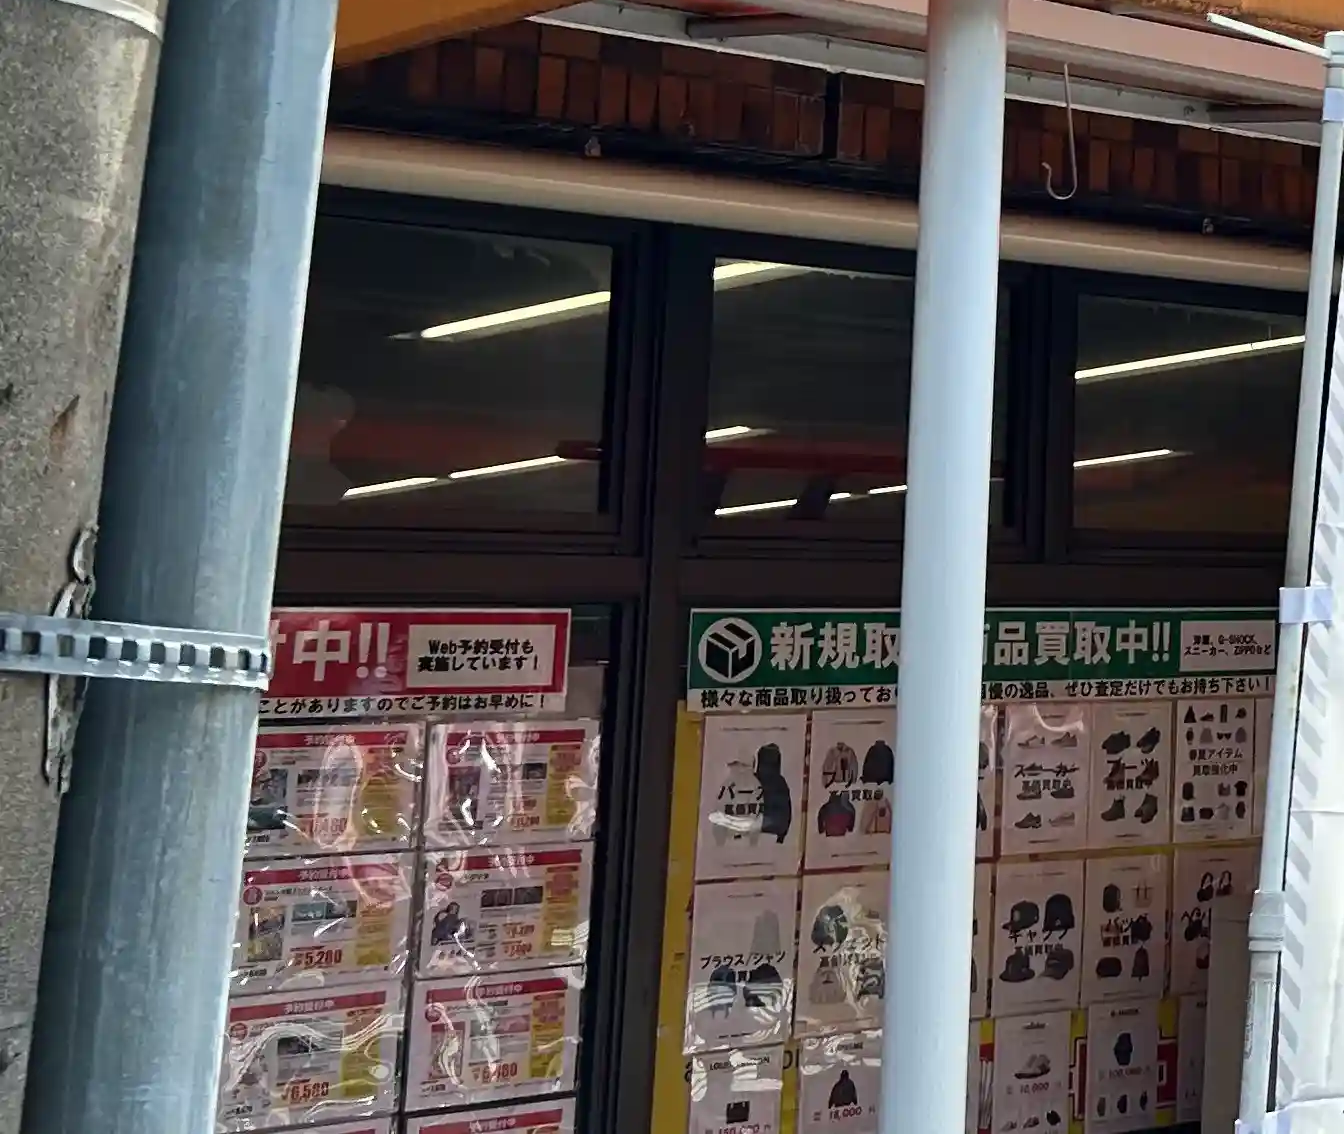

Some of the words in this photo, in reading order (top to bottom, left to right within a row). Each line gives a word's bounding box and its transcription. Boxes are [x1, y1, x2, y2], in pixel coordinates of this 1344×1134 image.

[428, 638, 535, 656] Web予約受付も
